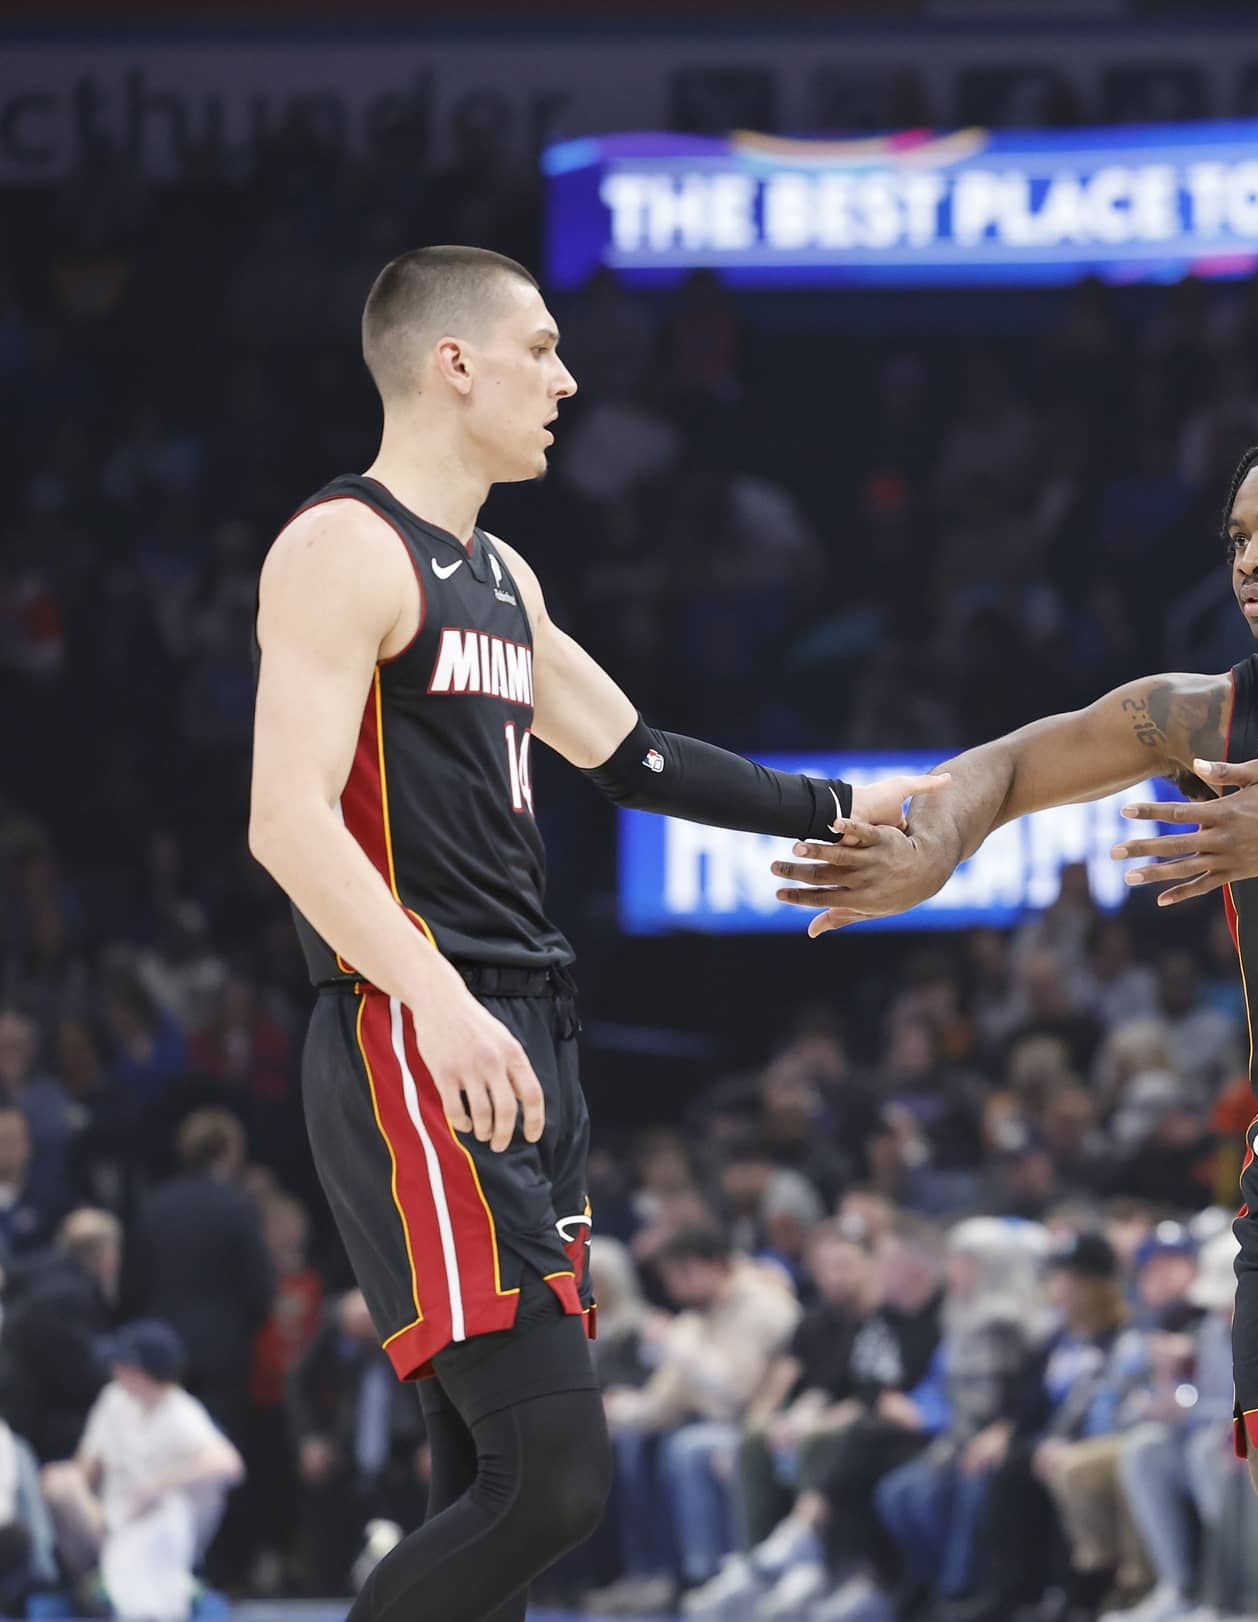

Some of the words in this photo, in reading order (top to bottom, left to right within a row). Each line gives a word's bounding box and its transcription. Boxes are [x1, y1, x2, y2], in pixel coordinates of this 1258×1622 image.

[602, 173, 754, 251] THE
[765, 171, 946, 250] BEST
[953, 163, 1177, 248] PLACE
